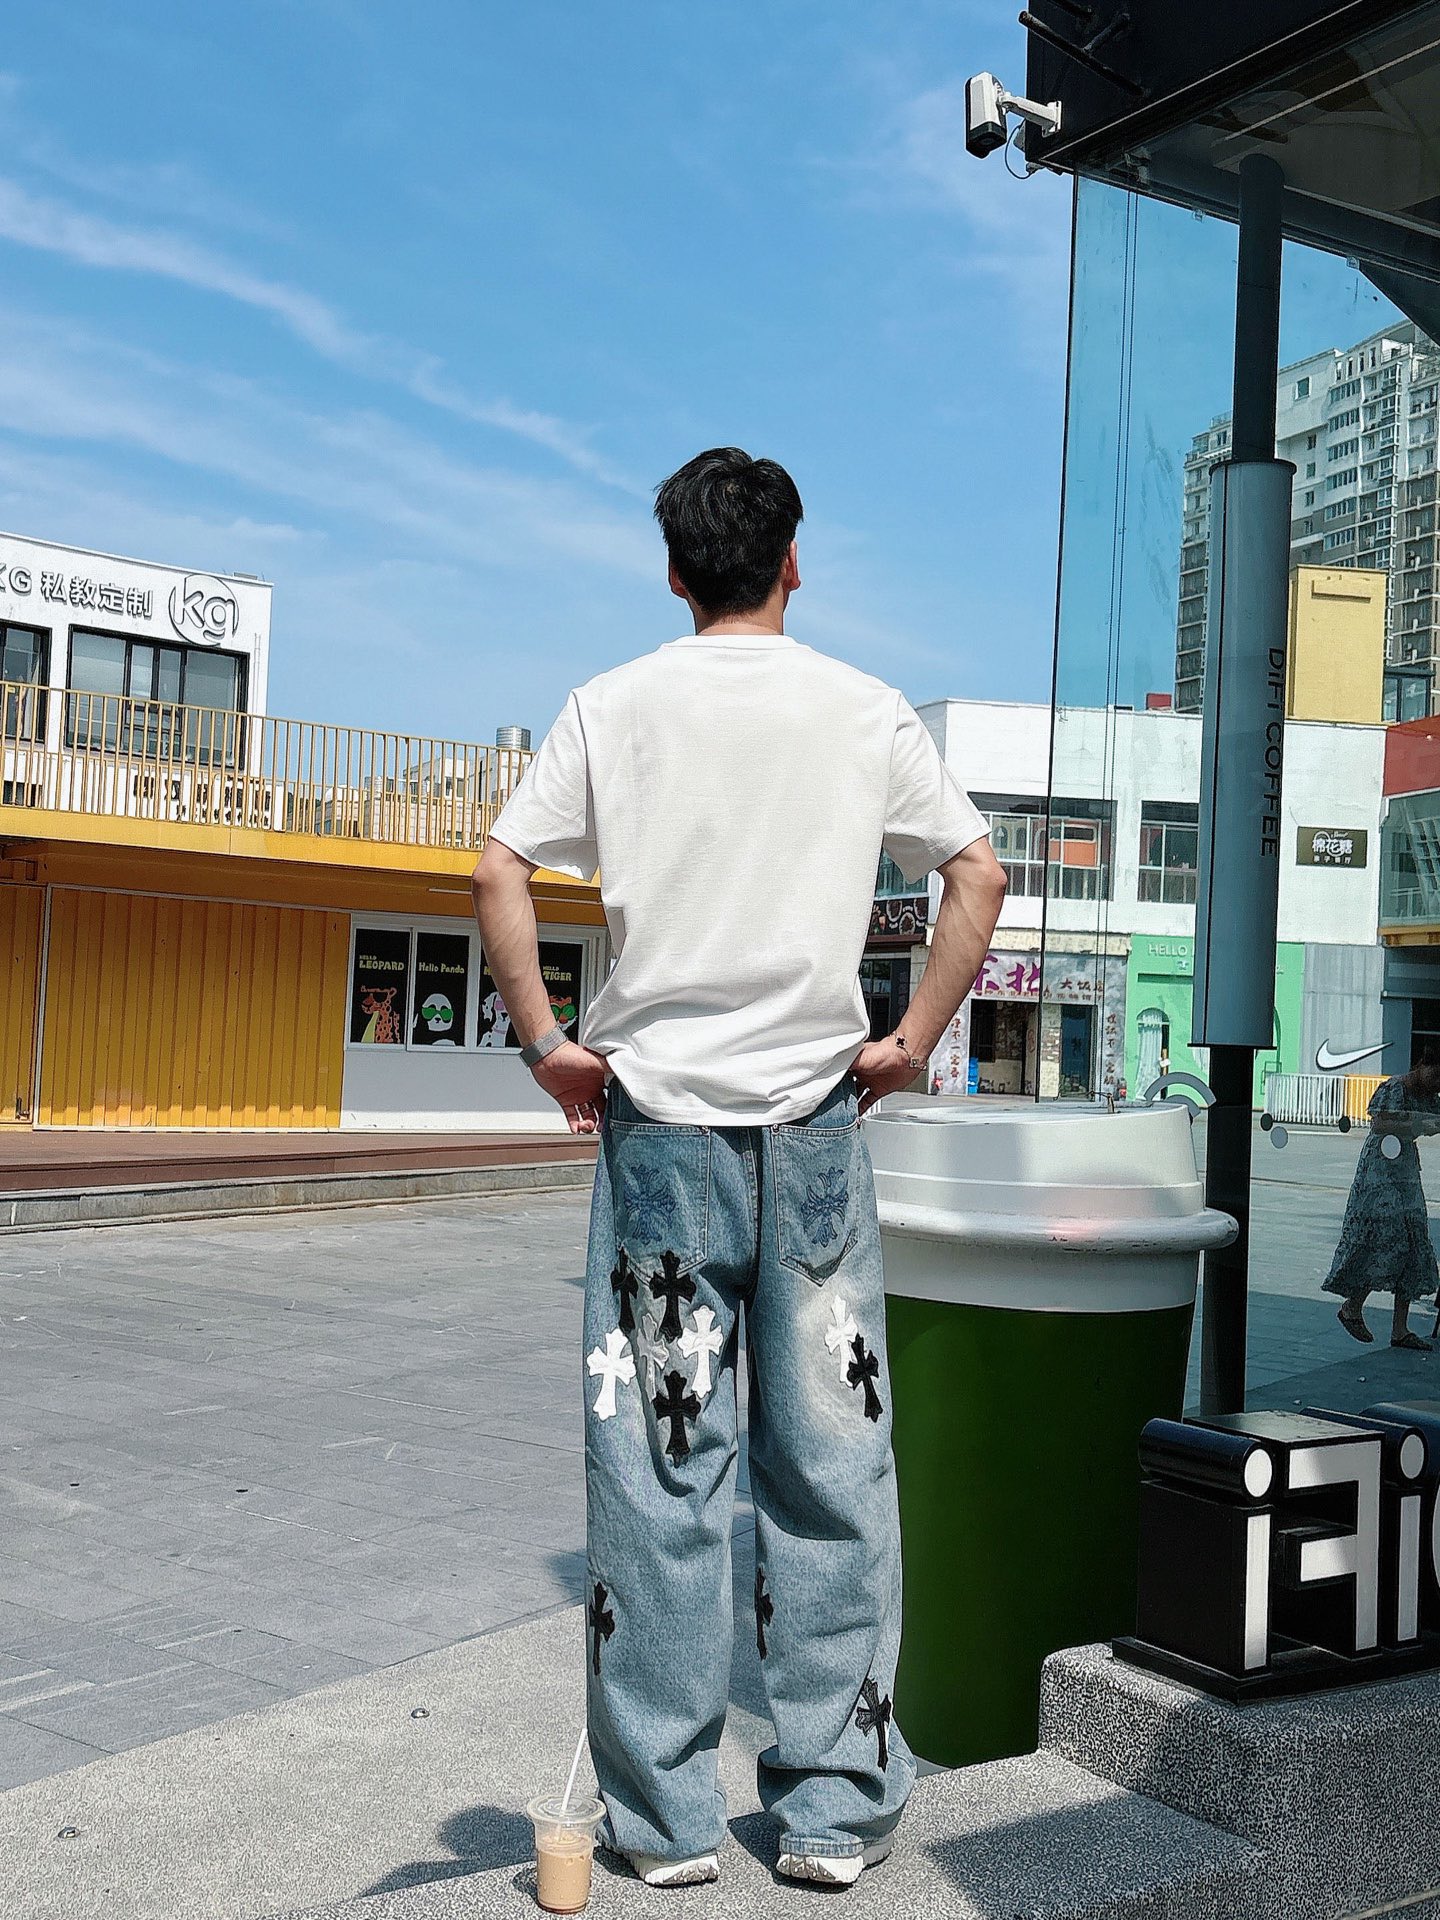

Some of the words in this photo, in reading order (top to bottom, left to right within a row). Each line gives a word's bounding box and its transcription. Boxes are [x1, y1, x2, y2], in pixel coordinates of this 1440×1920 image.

[41, 570, 154, 619] 私教定制
[1260, 721, 1283, 857] COFFEE
[1147, 942, 1188, 957] HELLO
[359, 960, 405, 971] LEOPARD
[418, 961, 439, 973] Hello
[440, 963, 465, 974] Panda
[542, 970, 572, 982] TIGER
